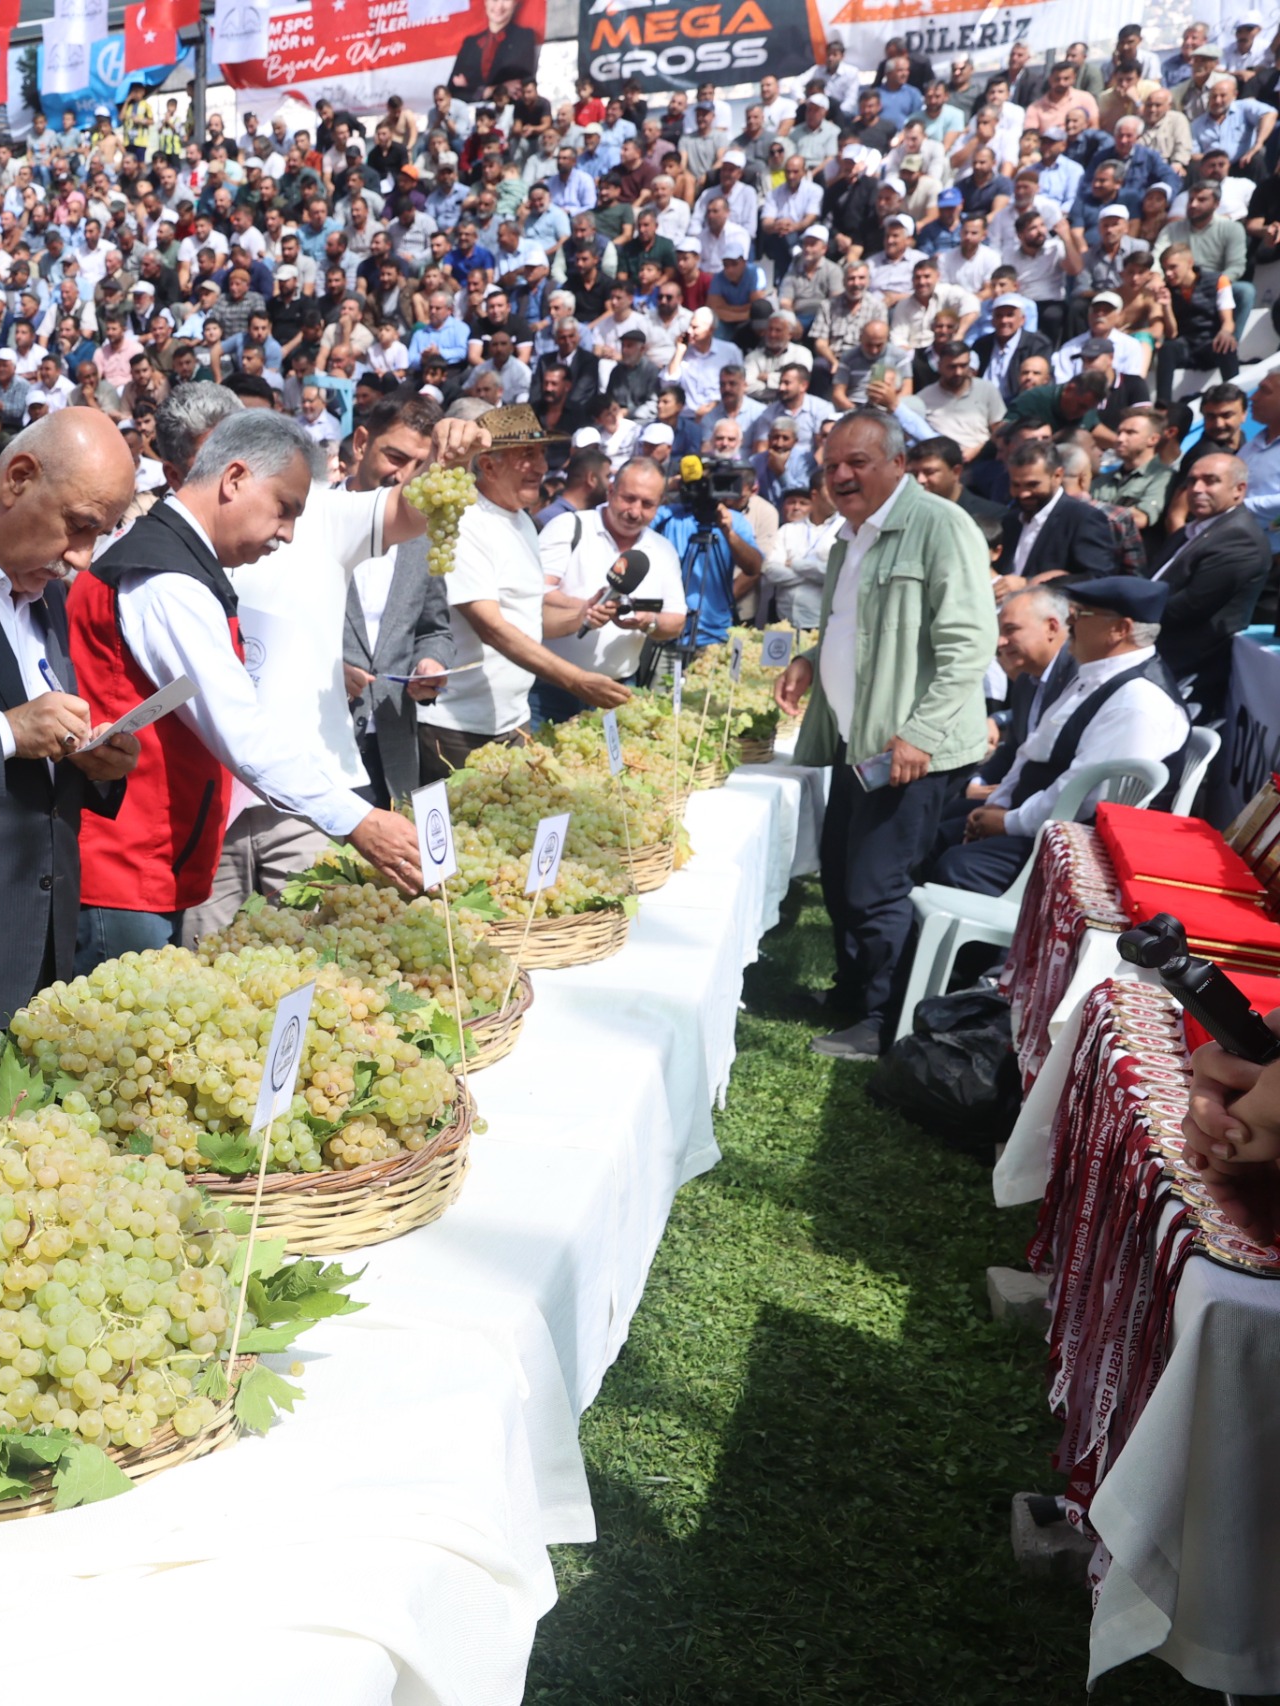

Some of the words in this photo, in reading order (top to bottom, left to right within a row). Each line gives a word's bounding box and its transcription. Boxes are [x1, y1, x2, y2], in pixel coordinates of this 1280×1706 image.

[591, 0, 773, 50] MEGA
[904, 10, 1032, 53] DİLERİZ
[590, 37, 768, 82] GROSS
